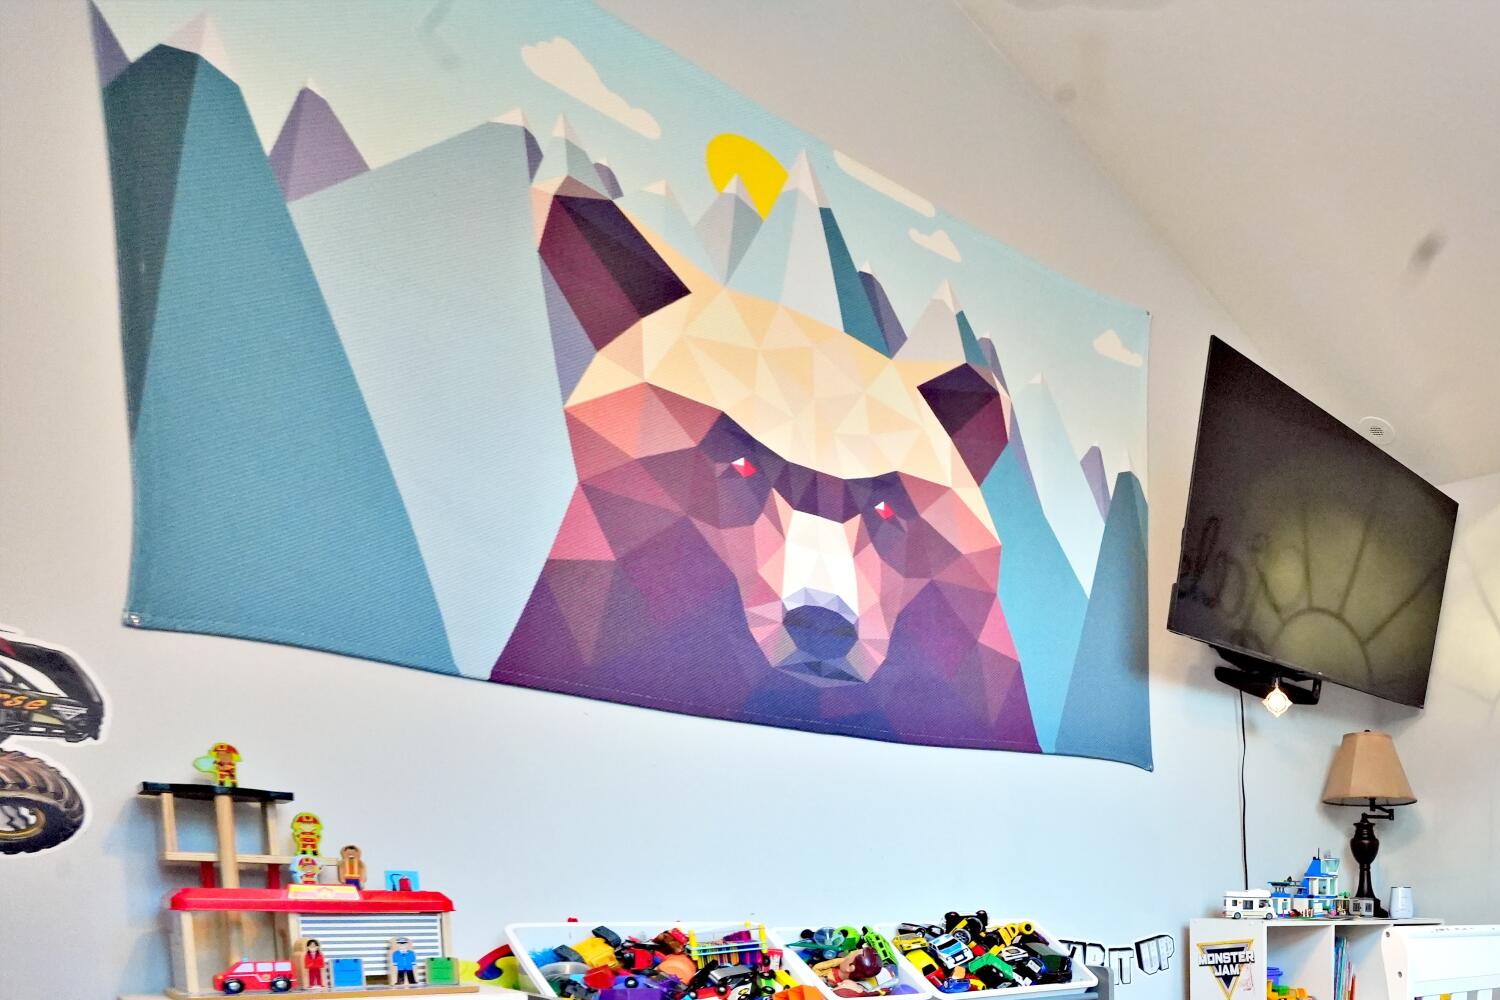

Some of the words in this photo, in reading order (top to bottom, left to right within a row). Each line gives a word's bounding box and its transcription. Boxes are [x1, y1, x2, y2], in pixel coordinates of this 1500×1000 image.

[1134, 934, 1175, 976] UP
[1198, 950, 1255, 967] MONSTER
[1214, 963, 1240, 977] JAM
